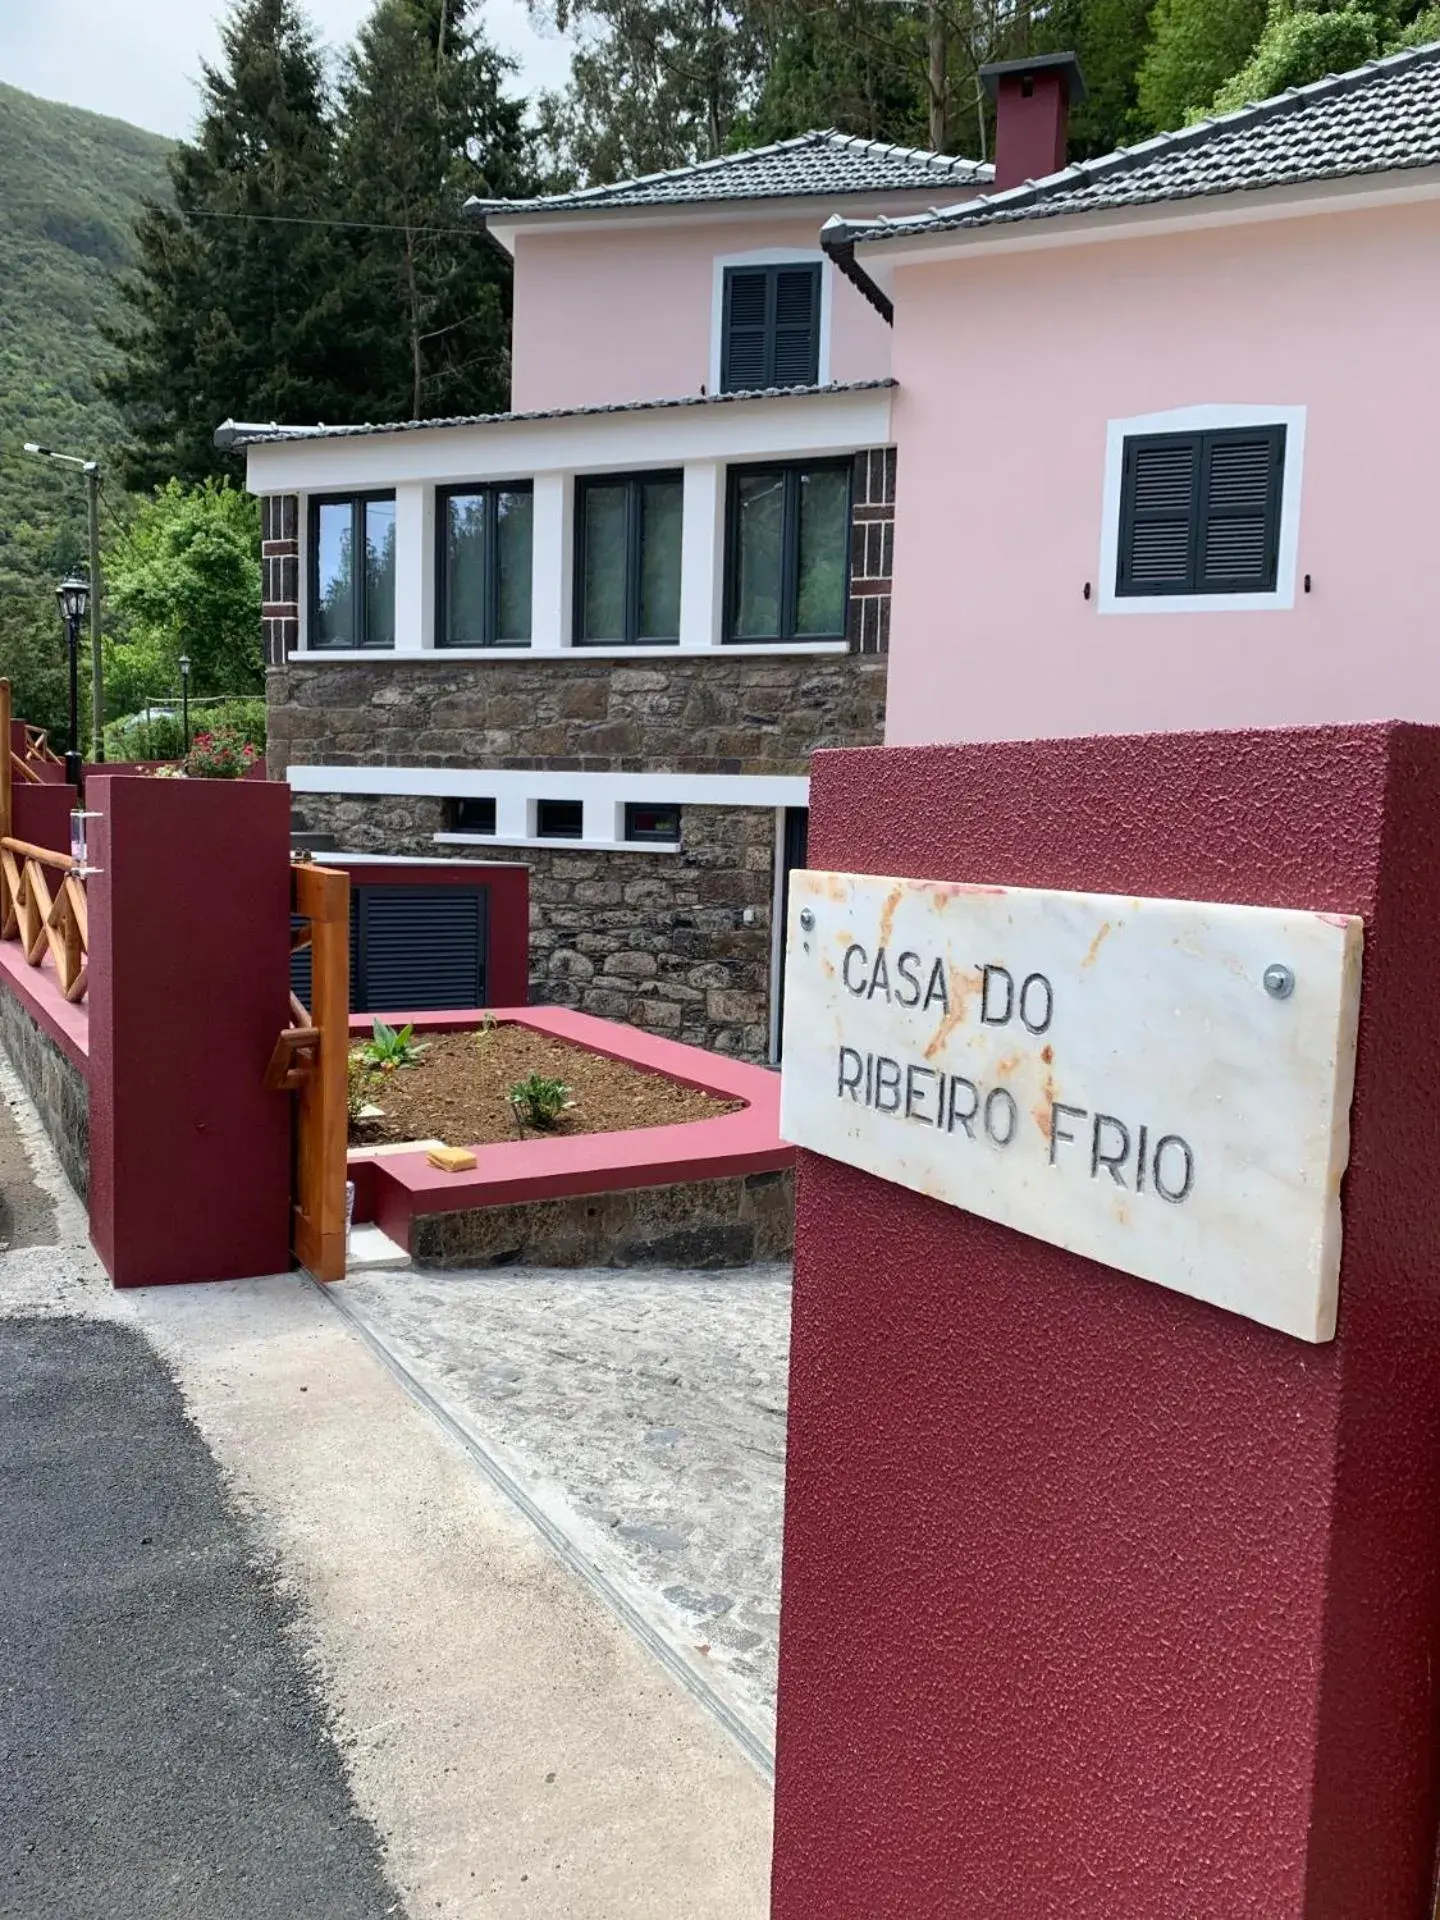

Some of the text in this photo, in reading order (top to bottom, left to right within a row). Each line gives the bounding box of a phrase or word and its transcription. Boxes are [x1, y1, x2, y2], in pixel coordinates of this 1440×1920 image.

[842, 943, 1054, 1035] CASA DO
[838, 1046, 1195, 1204] RIBEIRO FRIO
